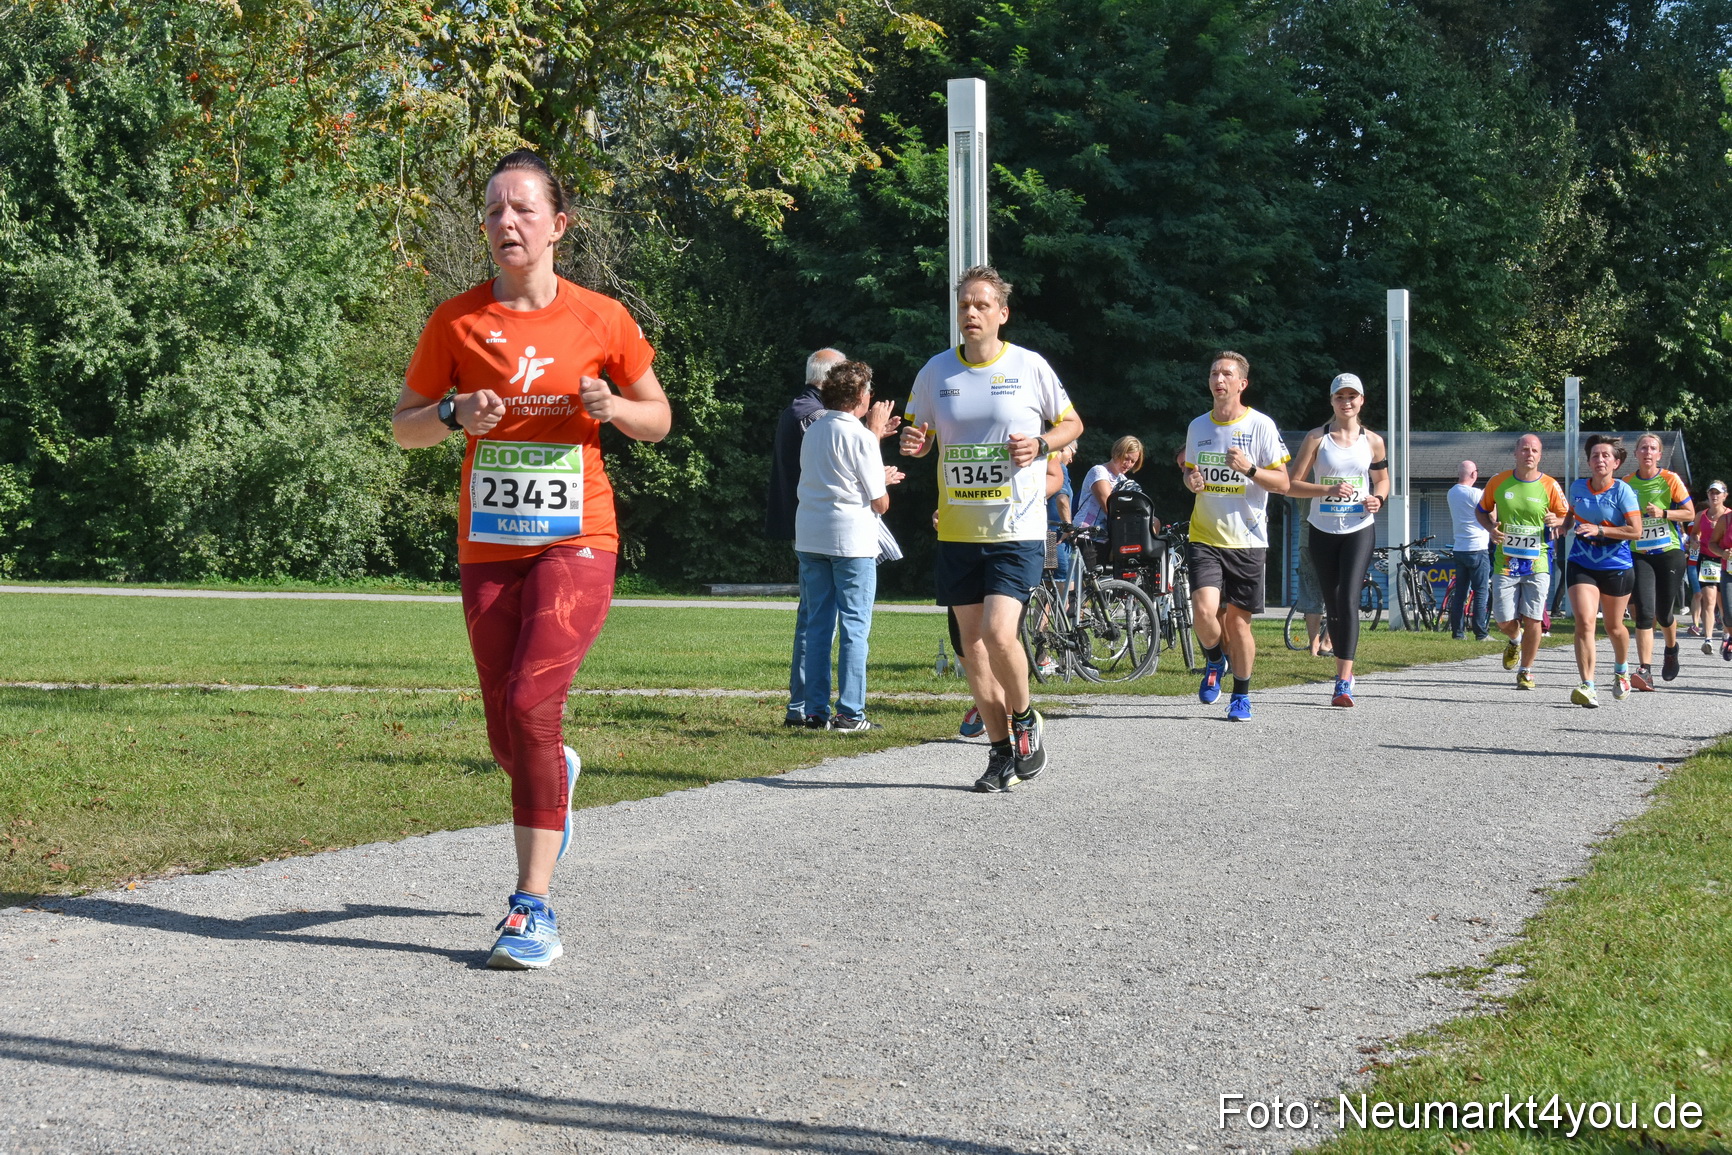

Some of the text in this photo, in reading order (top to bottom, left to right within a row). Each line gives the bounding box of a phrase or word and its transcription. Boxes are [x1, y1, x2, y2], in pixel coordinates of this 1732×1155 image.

[991, 375, 1005, 384] 20
[503, 395, 570, 406] nrunners
[479, 444, 572, 470] BOCK
[947, 446, 1004, 460] BOCK
[951, 465, 1003, 484] 1345
[1204, 468, 1240, 482] 1064
[482, 477, 567, 510] 2343
[955, 490, 1002, 498] MANFRED
[497, 518, 549, 533] KARIN
[1642, 518, 1665, 526] OCK
[1507, 525, 1537, 535] BOCK
[1507, 536, 1536, 547] 2712
